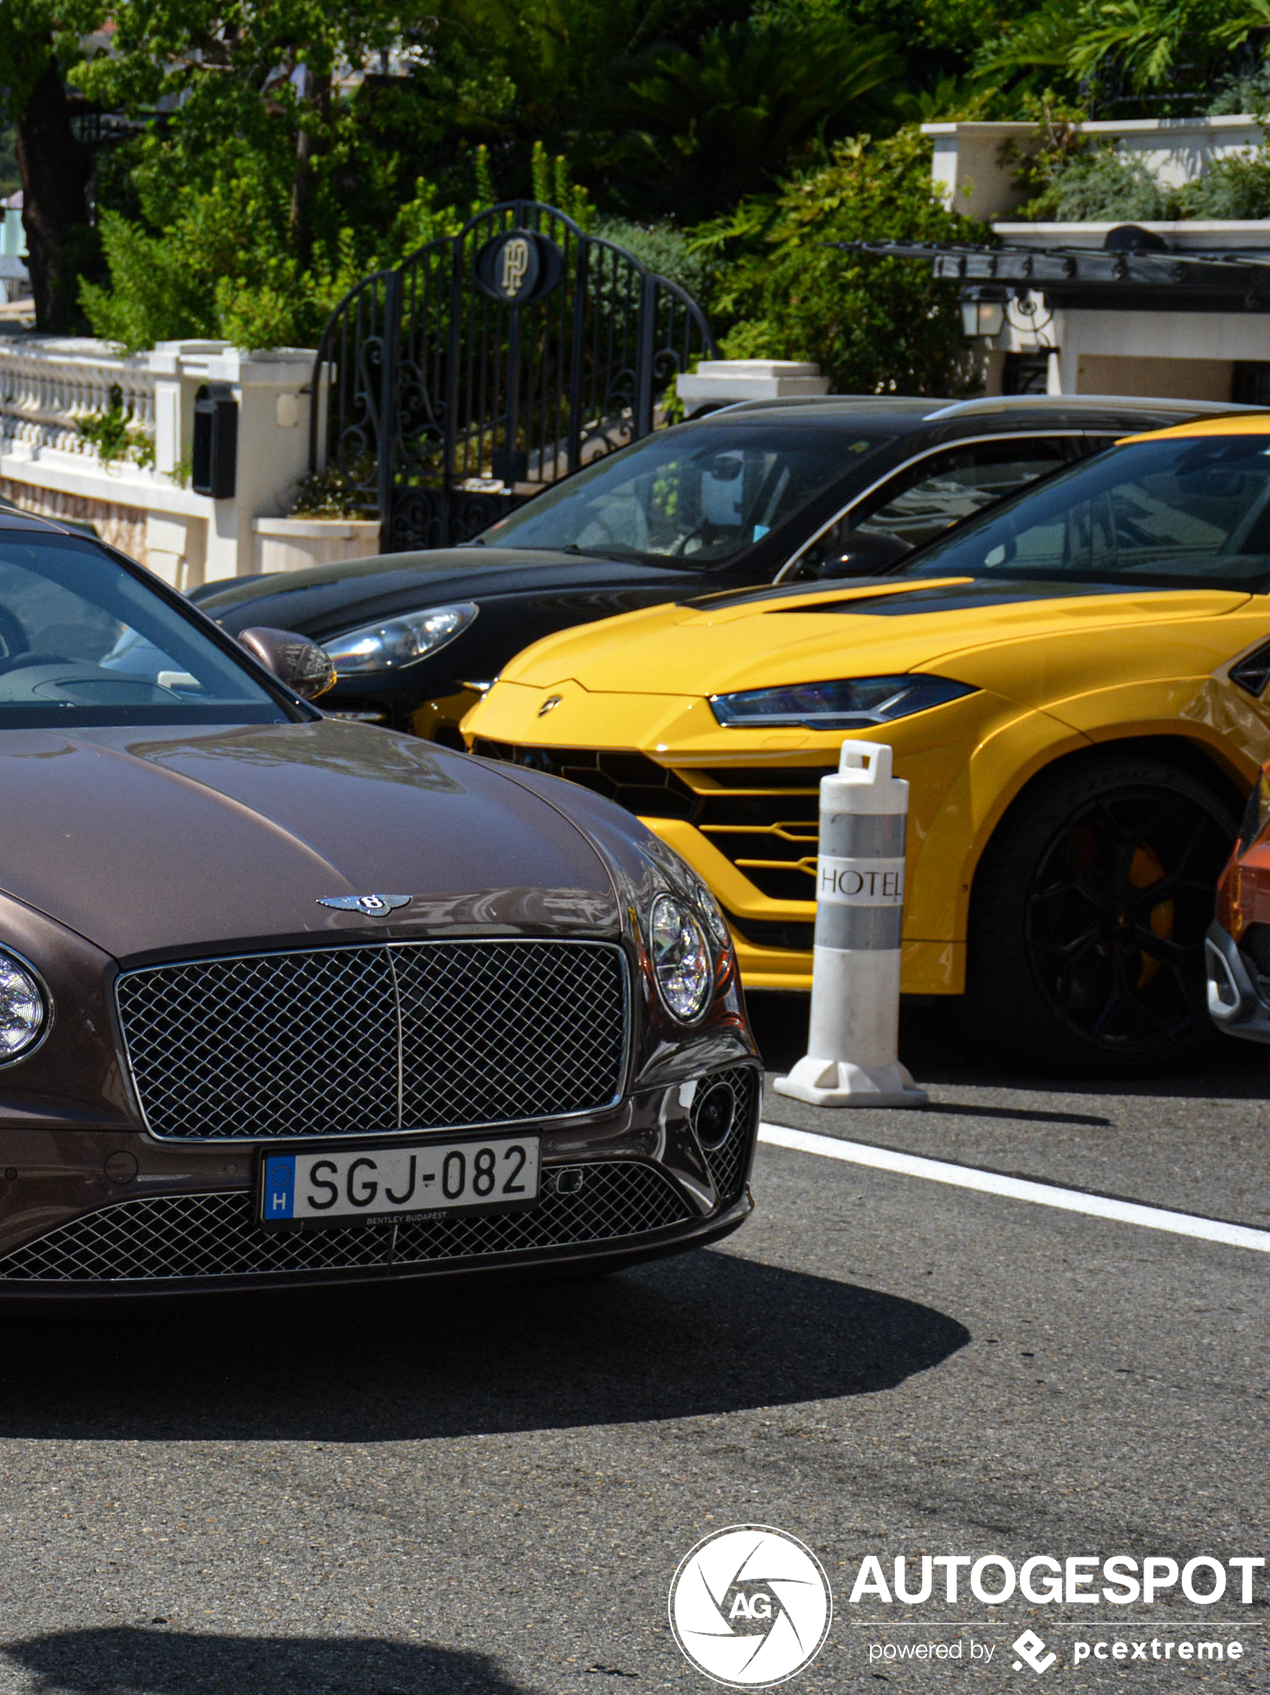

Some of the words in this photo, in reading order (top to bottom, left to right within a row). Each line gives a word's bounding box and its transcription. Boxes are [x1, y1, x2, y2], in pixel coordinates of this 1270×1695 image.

[821, 867, 903, 896] HOTEL
[307, 1144, 527, 1210] SGJ-082
[273, 1192, 286, 1210] H
[366, 1215, 404, 1226] BENTLEY
[405, 1211, 448, 1223] BUDAPEST
